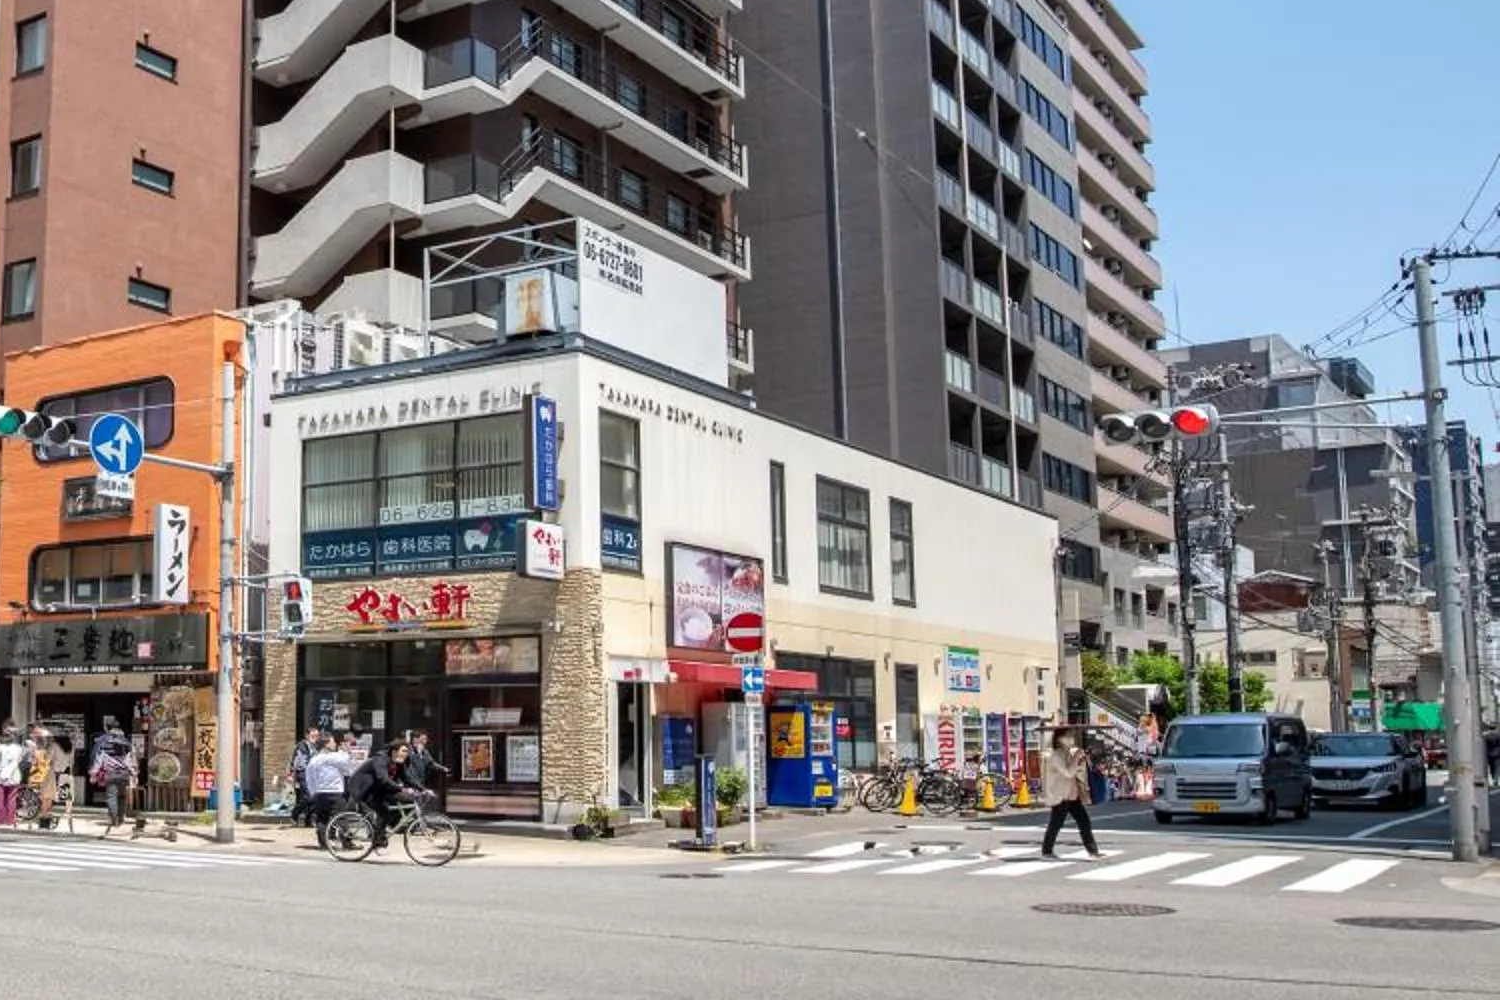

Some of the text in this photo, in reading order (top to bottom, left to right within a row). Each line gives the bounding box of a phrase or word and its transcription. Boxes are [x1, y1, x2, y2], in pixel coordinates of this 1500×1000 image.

[298, 405, 388, 434] TAKAHARA
[399, 394, 469, 422] DENTAL
[599, 383, 743, 443] TAKAHARA DENTAL CLINIC
[167, 509, 187, 598] ラーメン
[309, 534, 451, 560] たかはら 歯科医院
[347, 580, 471, 624] やよい軒
